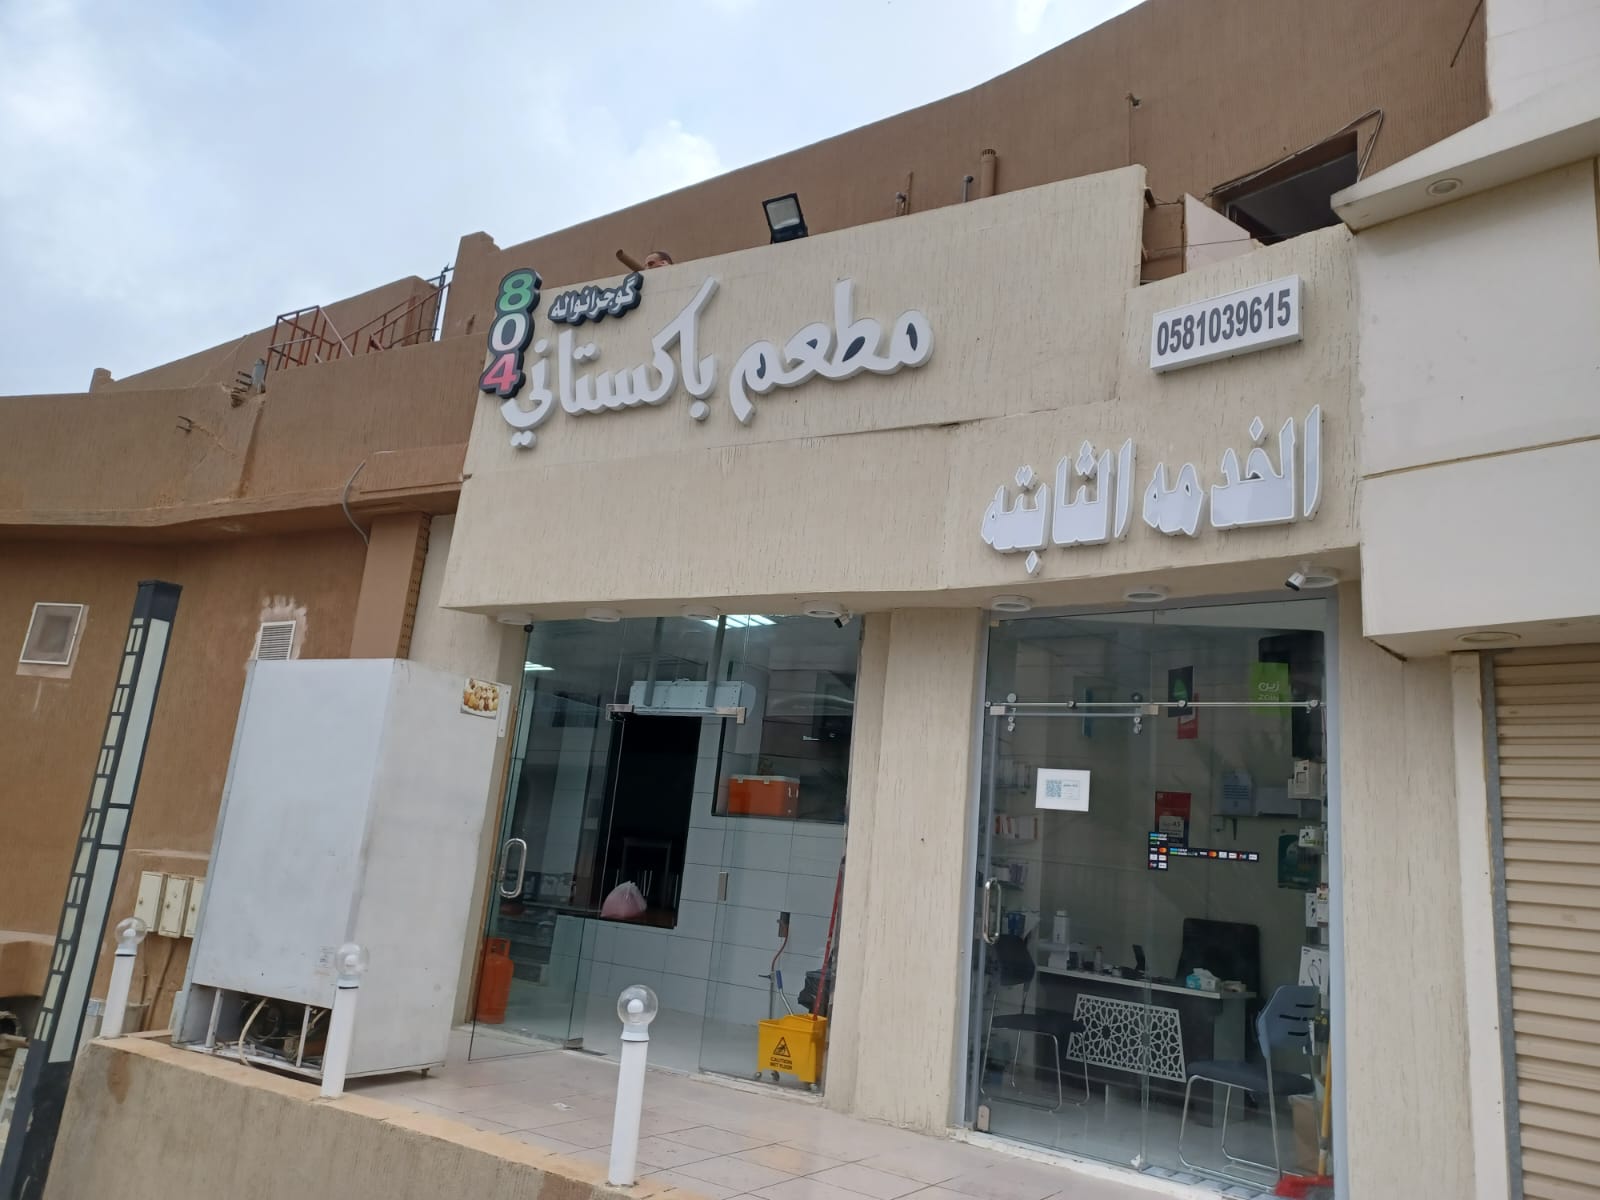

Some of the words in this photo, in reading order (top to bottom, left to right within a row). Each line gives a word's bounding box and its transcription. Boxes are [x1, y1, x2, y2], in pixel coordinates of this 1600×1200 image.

[481, 270, 537, 395] 804
[501, 276, 720, 448] باكستاني
[729, 278, 933, 425] مطعم
[1156, 288, 1291, 356] 0581039615
